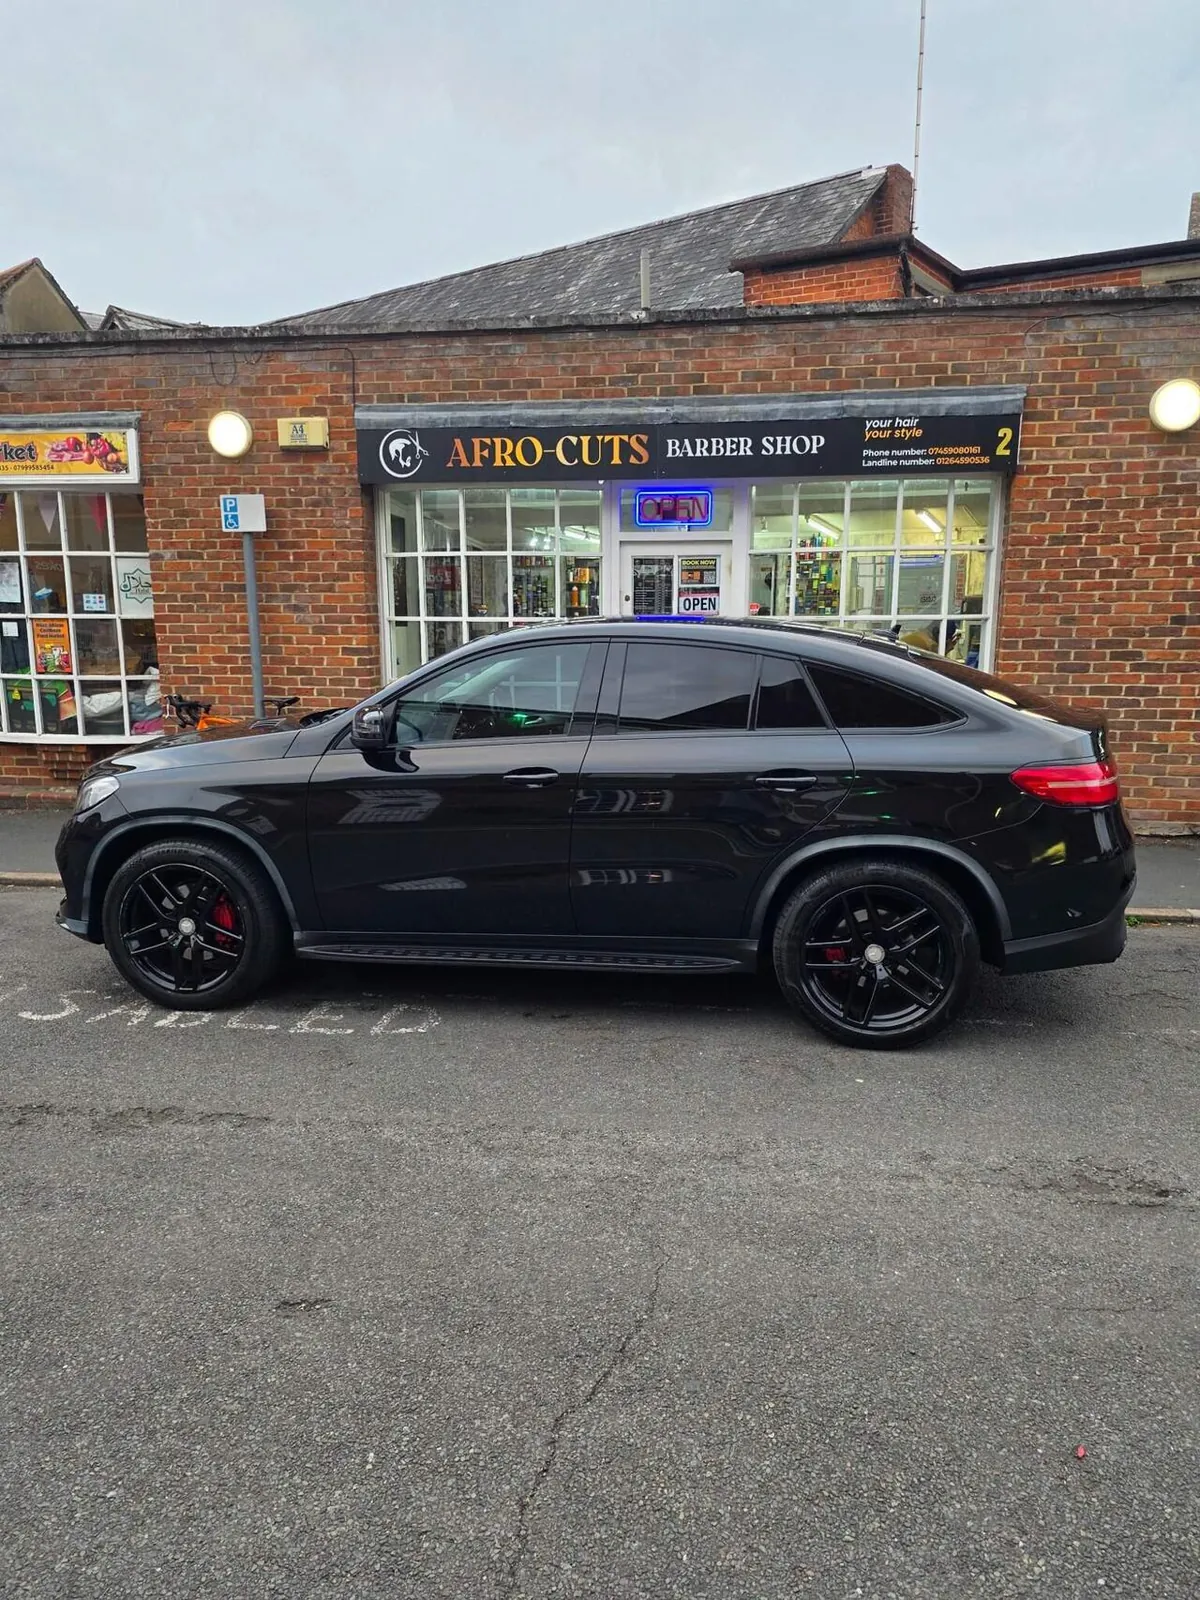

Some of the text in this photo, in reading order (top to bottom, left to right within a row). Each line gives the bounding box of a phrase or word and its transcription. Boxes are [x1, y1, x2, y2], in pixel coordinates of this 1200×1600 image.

[865, 416, 919, 430] your hair
[864, 427, 923, 441] your style
[666, 435, 826, 458] BARBER SHOP
[995, 427, 1013, 456] 2
[446, 434, 650, 467] AFRO-CUTS
[862, 446, 981, 457] Phone number: 07459080161
[862, 456, 990, 467] Landline number: 01264590536
[226, 499, 236, 511] P
[641, 496, 708, 521] OPEN
[683, 597, 716, 611] OPEN
